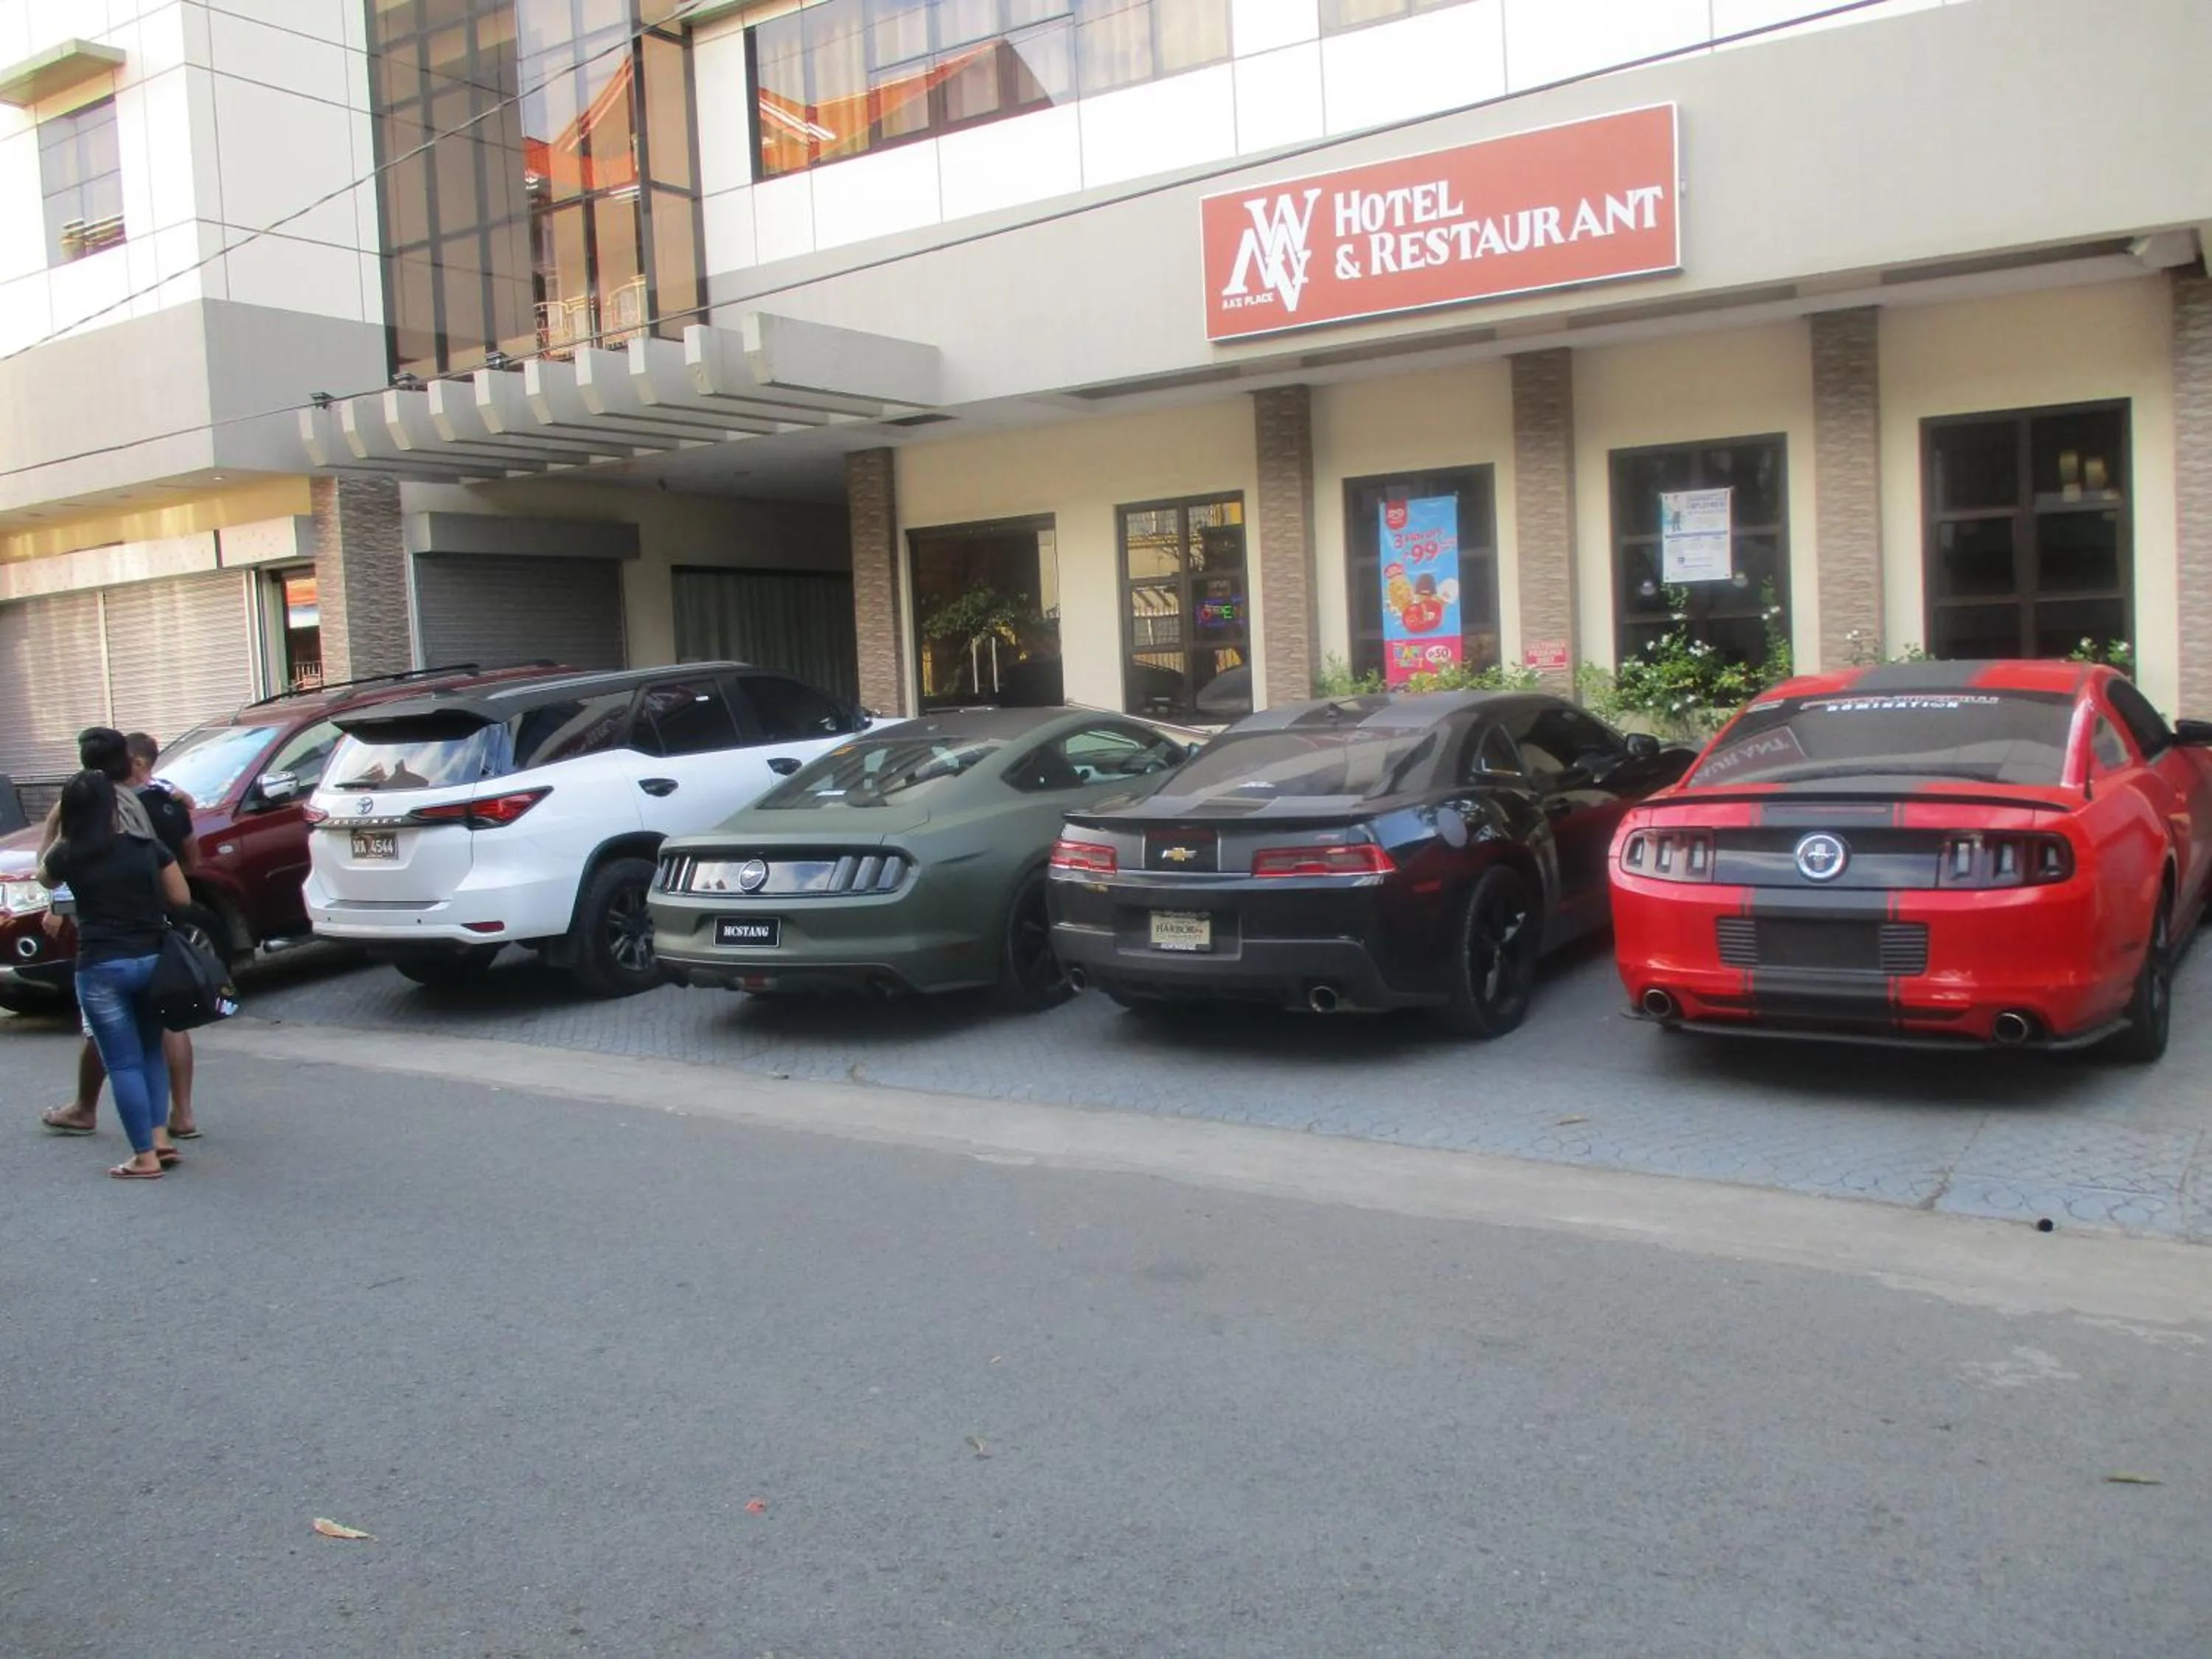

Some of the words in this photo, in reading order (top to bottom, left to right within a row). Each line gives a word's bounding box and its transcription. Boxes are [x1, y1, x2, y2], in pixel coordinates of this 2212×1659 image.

[1335, 180, 1464, 237] HOTEL
[1335, 244, 1361, 280] &
[1371, 186, 1663, 277] RESTAURANT
[1245, 292, 1274, 306] PLACE
